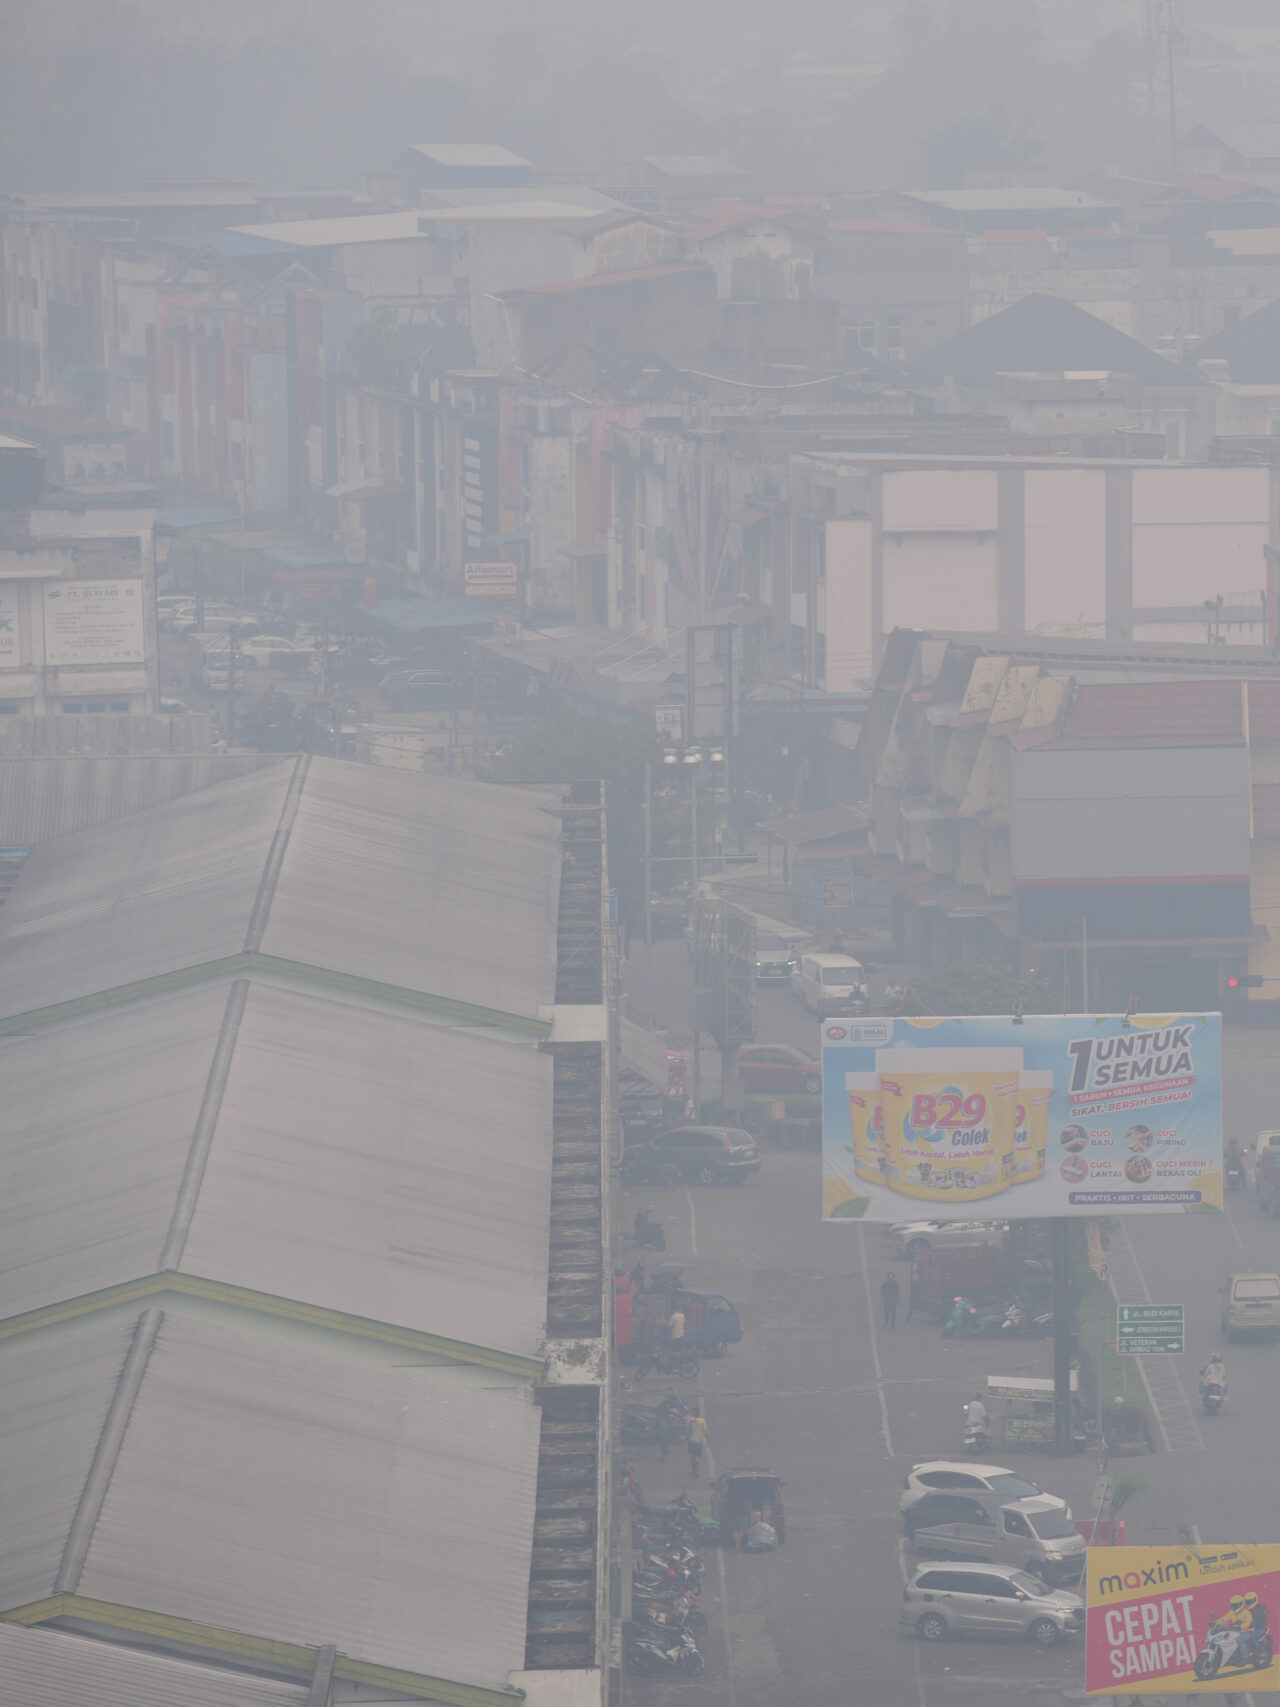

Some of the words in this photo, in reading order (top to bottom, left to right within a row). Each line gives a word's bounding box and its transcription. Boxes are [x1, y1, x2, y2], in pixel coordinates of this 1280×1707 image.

[1070, 1040, 1093, 1092] 1
[1095, 1027, 1192, 1061] UNTUK
[1094, 1052, 1192, 1086] SEMUA
[1113, 1087, 1142, 1097] SEMUA
[1143, 1079, 1189, 1093] KEGUNAAN
[912, 1093, 987, 1128] B29
[1071, 1104, 1105, 1118] SIKAT,
[1108, 1098, 1148, 1112] BERSIH
[1150, 1090, 1192, 1105] SEMUA!
[951, 1128, 991, 1146] Colek
[1090, 1139, 1114, 1147] BAJU
[1090, 1161, 1112, 1169] CUCI
[1090, 1170, 1122, 1178] LANTAI
[1075, 1194, 1112, 1202] PRAKTIS
[1118, 1193, 1134, 1202] IRIT
[1141, 1193, 1196, 1201] SERBAGUNA
[1105, 1595, 1194, 1647] CEPAT
[1109, 1634, 1198, 1679] SAMPAI
